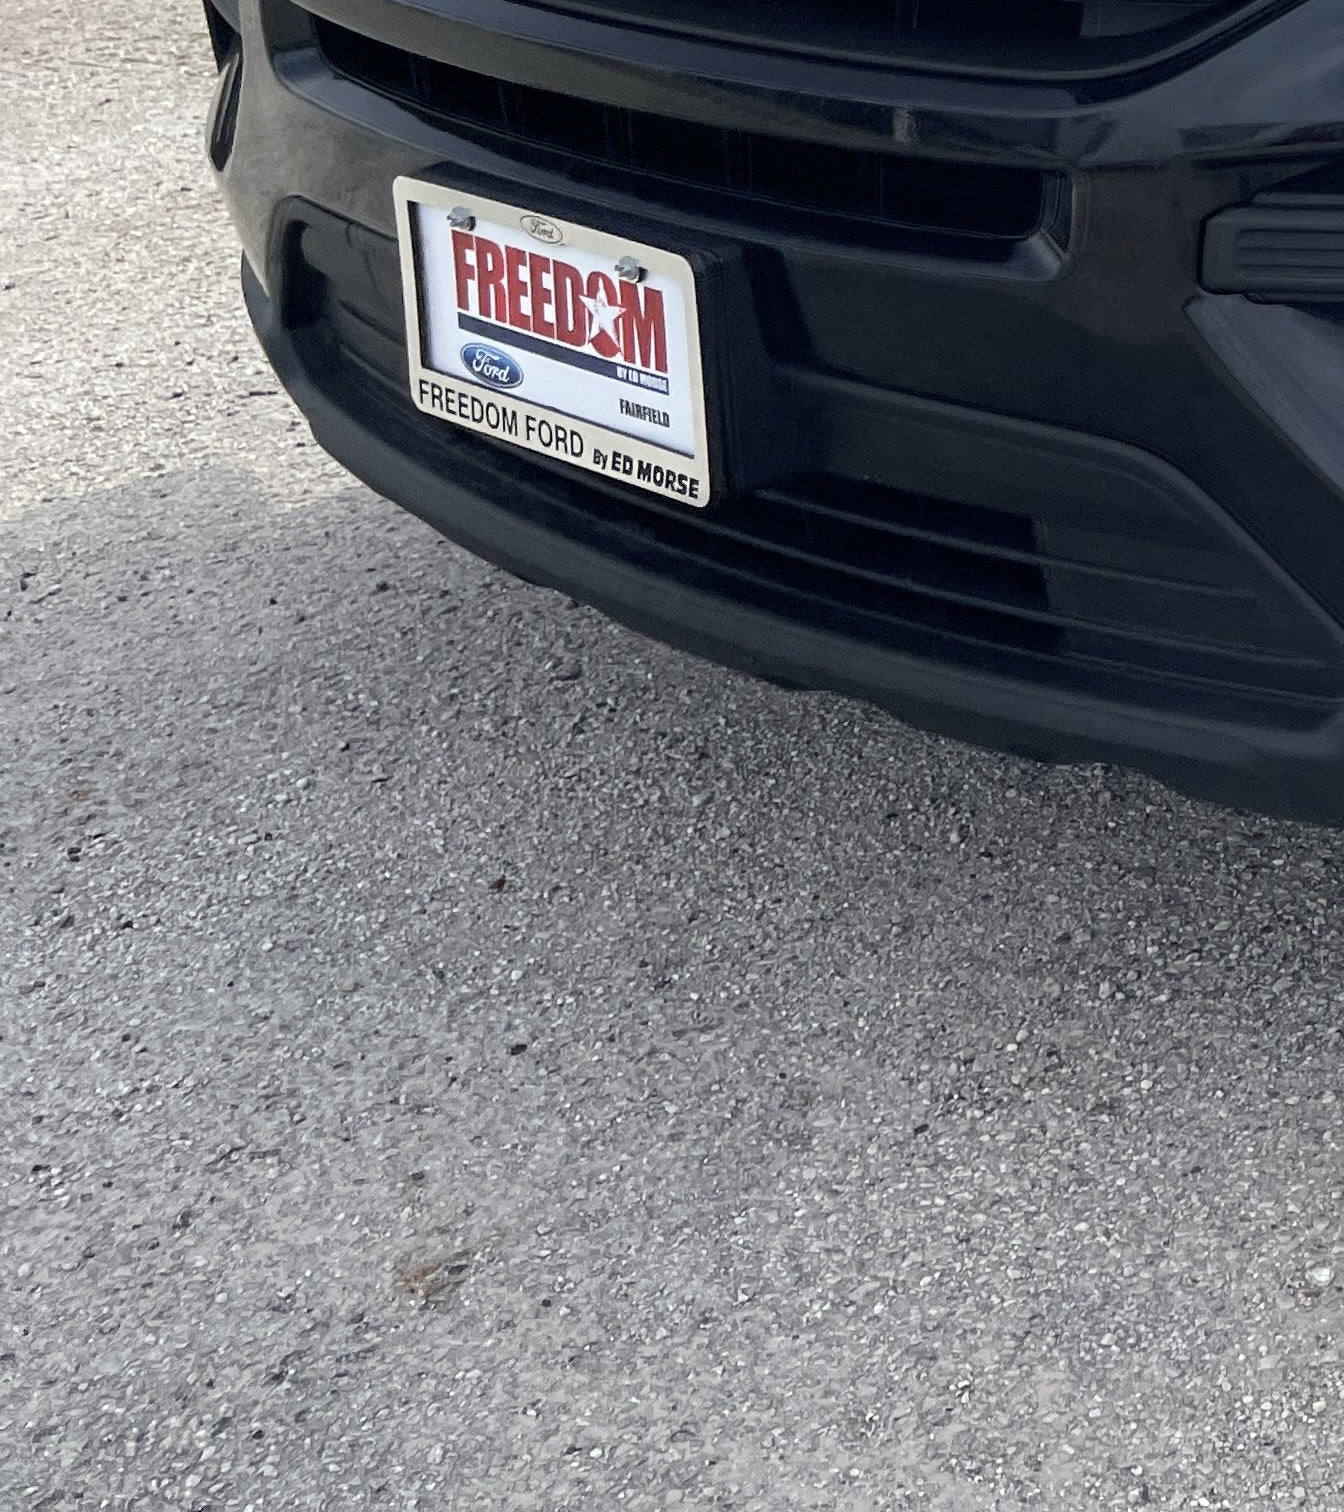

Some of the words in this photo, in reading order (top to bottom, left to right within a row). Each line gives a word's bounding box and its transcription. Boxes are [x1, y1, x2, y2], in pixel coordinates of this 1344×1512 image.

[530, 218, 554, 239] Ford
[452, 230, 669, 374] FREEDOM
[473, 349, 510, 382] Ford
[619, 398, 670, 428] FAIRFIELD
[419, 378, 518, 437] FREEDOM
[525, 414, 584, 458] FORD
[611, 450, 634, 475] ED
[637, 459, 700, 499] MORSE
